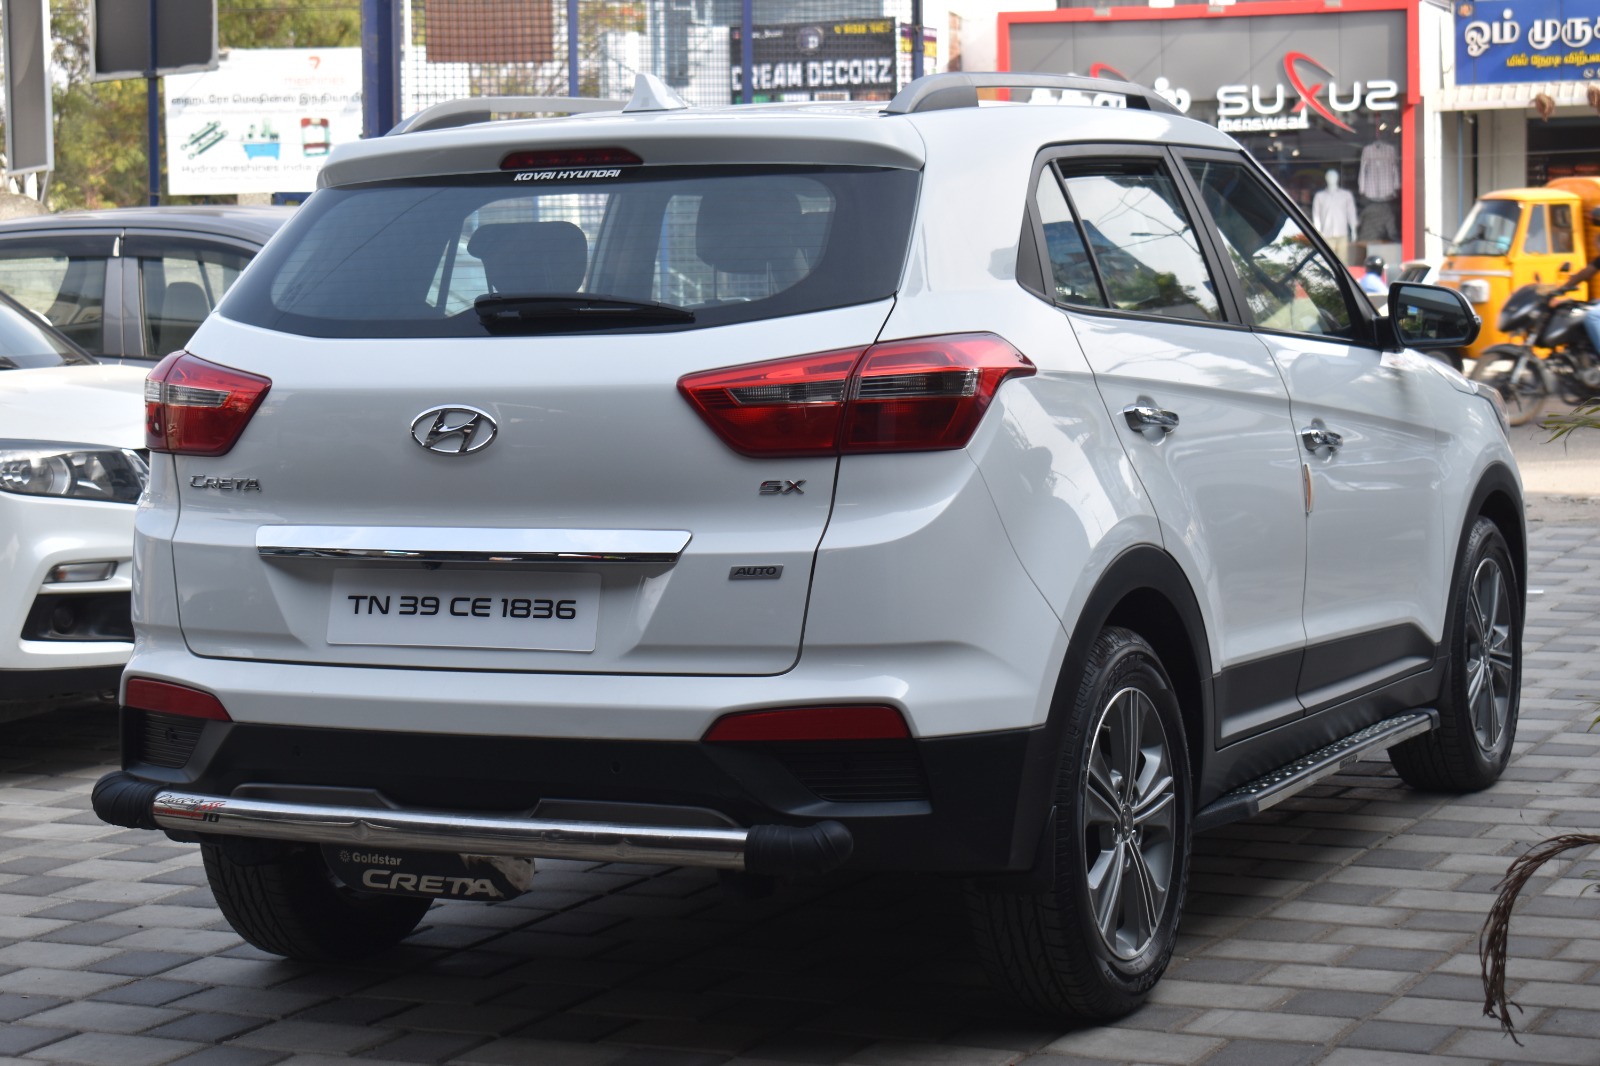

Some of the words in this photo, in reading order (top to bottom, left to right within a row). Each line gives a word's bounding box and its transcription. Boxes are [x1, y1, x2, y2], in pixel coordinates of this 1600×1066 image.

[1465, 8, 1520, 57] ஓம்
[1528, 16, 1600, 50] முரு
[807, 58, 892, 86] DECORZ
[514, 171, 557, 181] KOVAI
[557, 169, 622, 179] HYUNDAI
[190, 474, 263, 492] CRETA
[759, 479, 807, 495] SX
[734, 566, 777, 576] AUTO
[347, 595, 391, 614] TN
[399, 596, 440, 615] 39
[450, 597, 492, 617] CE
[501, 598, 577, 620] 1836
[352, 852, 403, 866] Goldstar
[362, 868, 505, 898] CRETA
